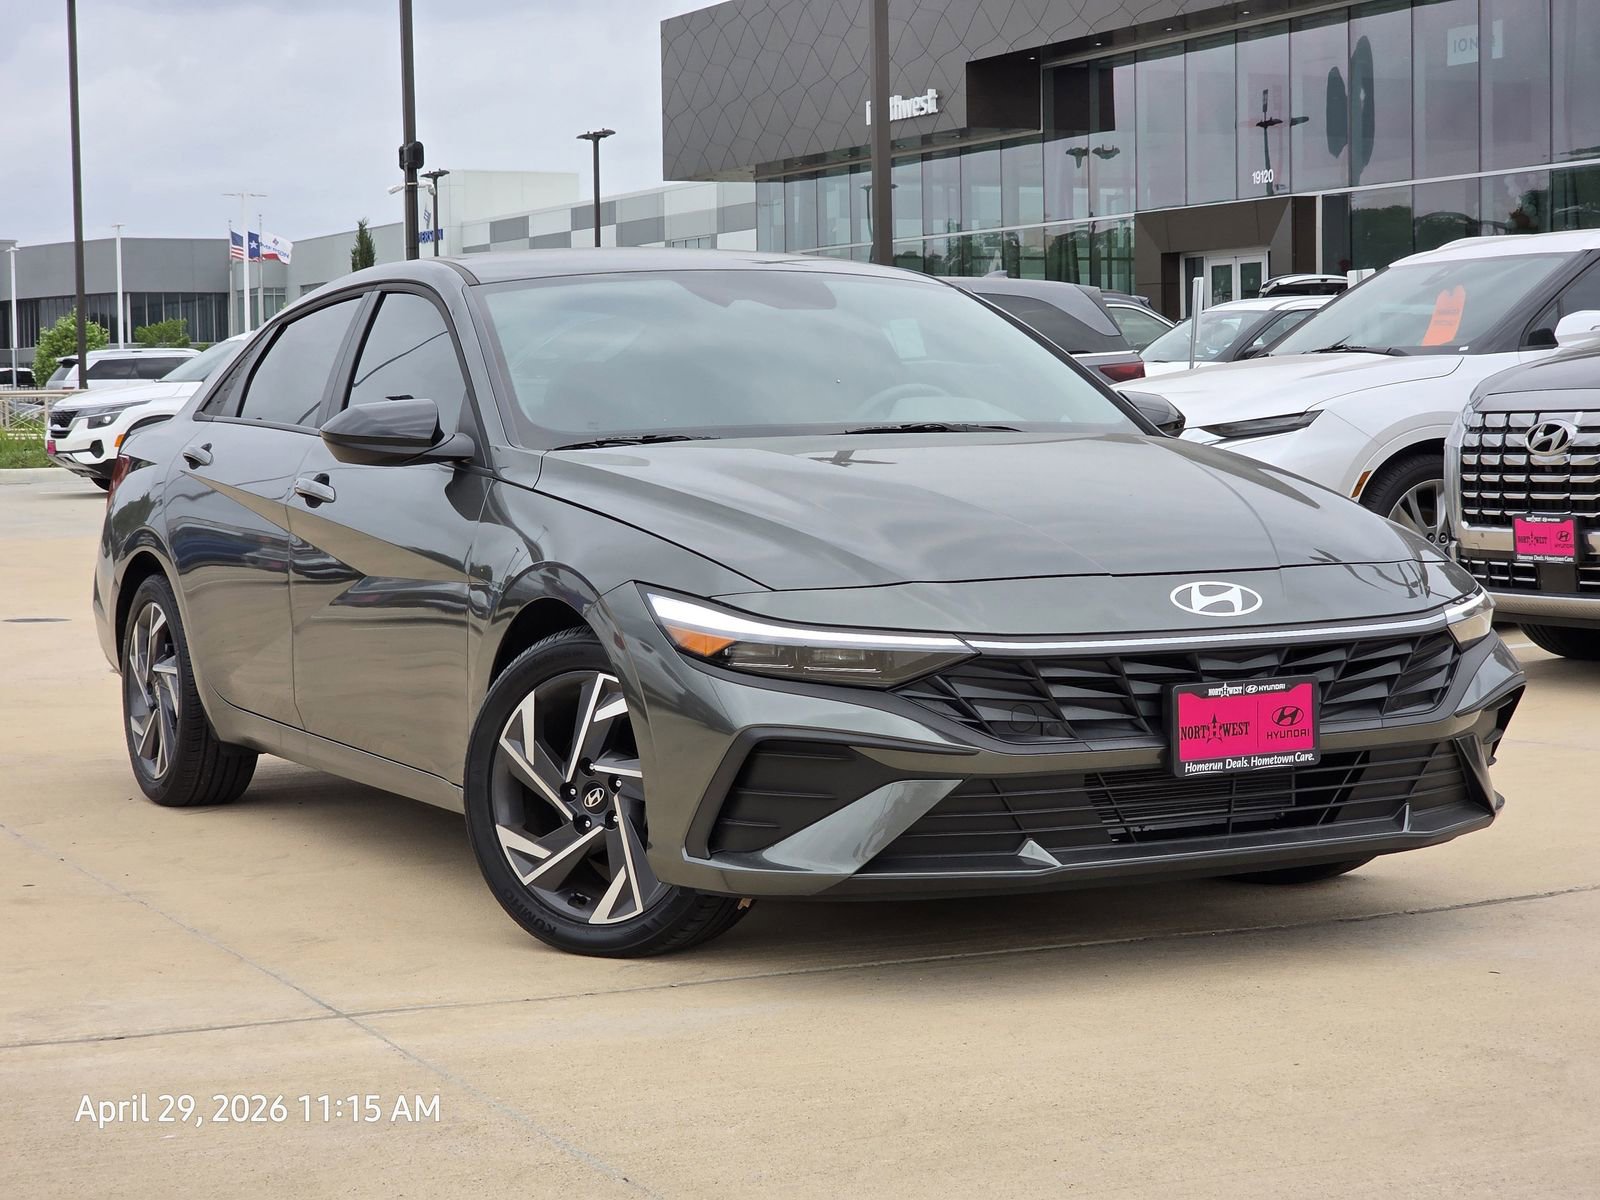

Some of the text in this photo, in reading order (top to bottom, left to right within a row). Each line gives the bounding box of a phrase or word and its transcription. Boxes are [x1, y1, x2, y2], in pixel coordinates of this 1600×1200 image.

[1251, 168, 1274, 185] 19120
[1258, 683, 1286, 692] HYUNDAI
[1266, 728, 1310, 740] HYUNDAI
[1185, 751, 1315, 773] Homerun Deals. Hometown Care.
